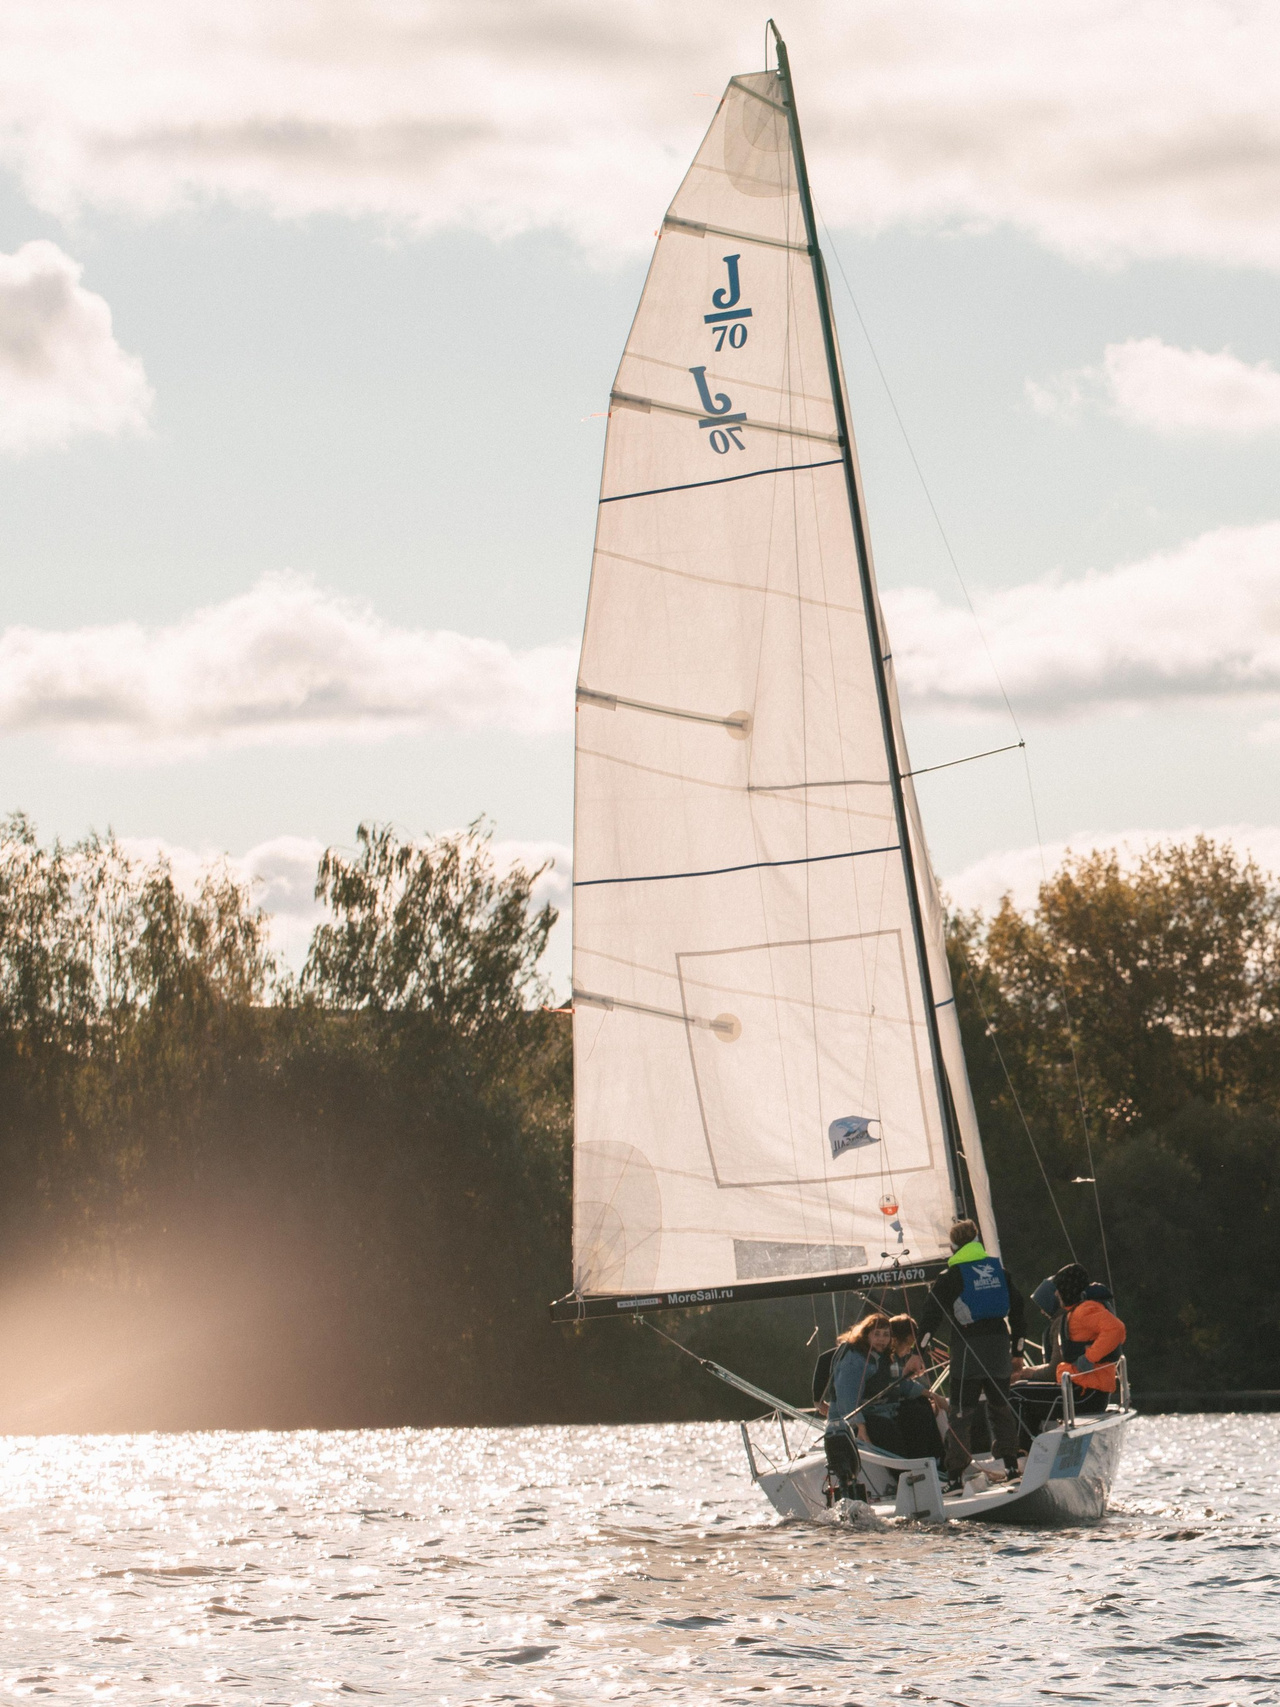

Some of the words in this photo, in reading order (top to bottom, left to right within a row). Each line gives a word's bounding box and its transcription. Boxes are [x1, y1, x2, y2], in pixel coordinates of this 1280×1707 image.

[712, 254, 741, 309] J
[712, 323, 748, 352] 70
[667, 1289, 734, 1305] MoreSail.ru
